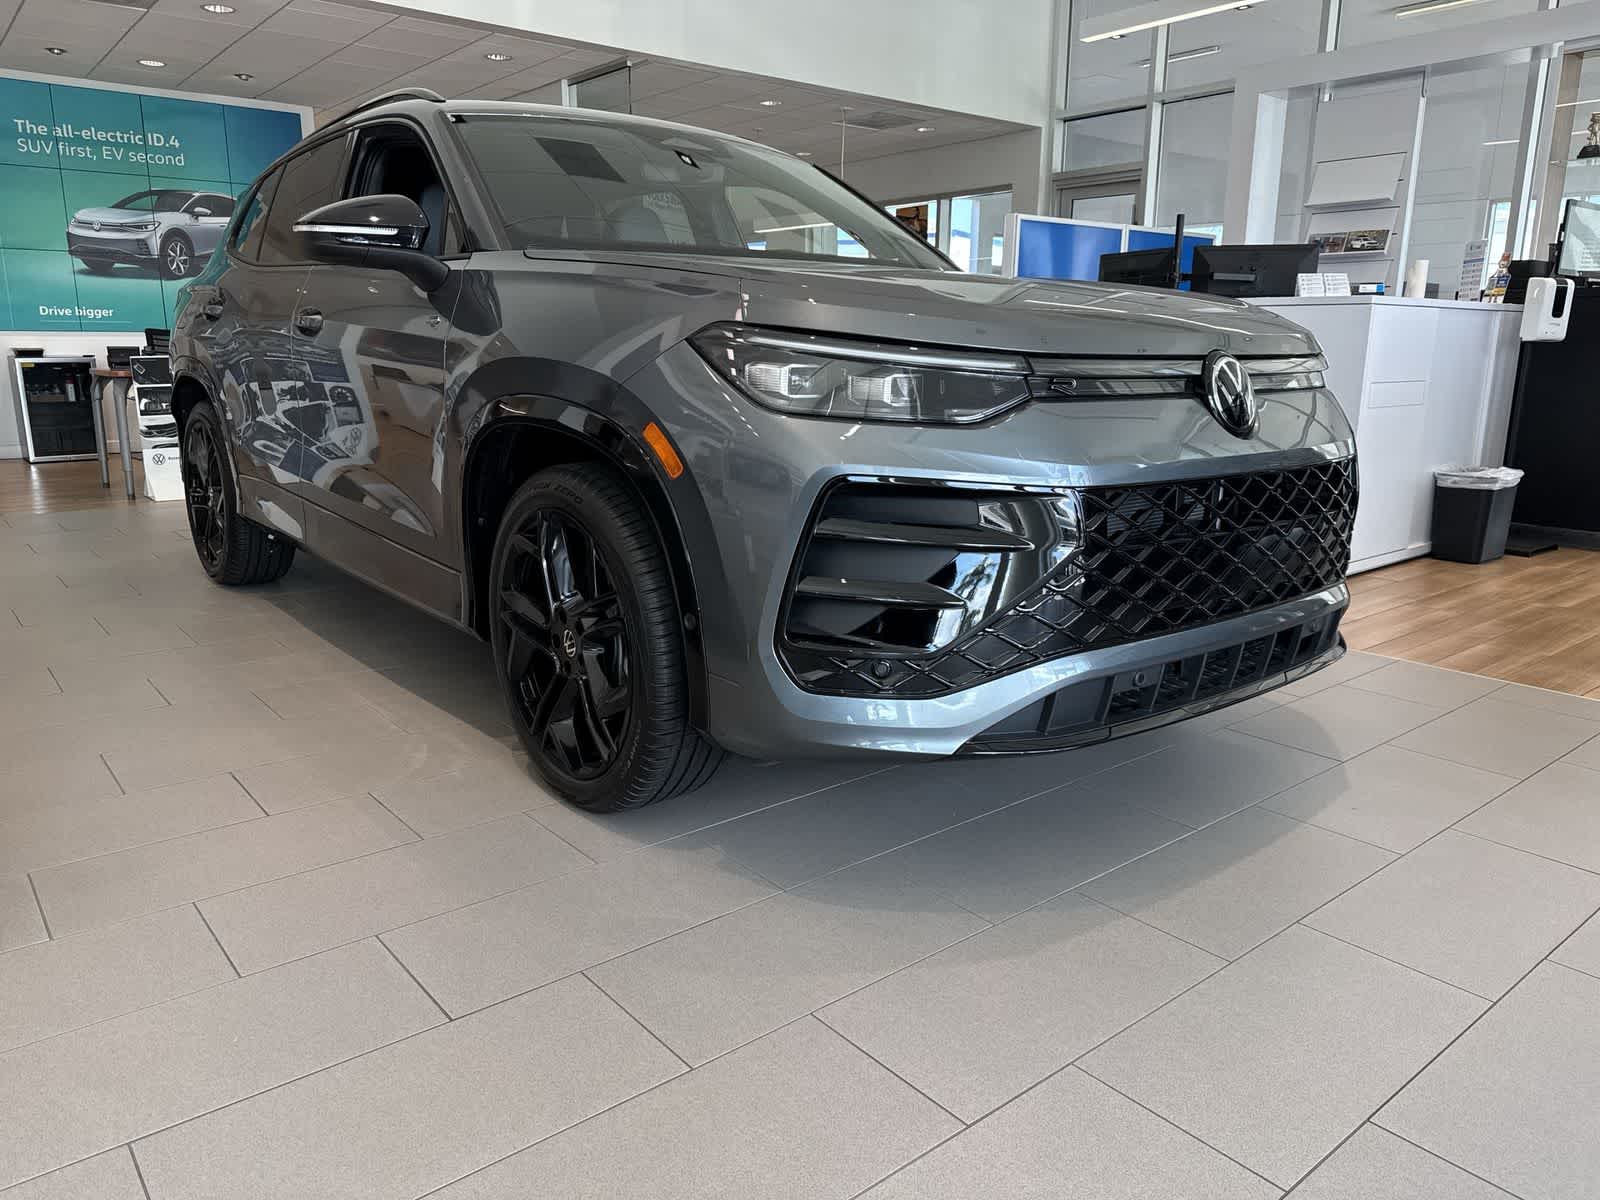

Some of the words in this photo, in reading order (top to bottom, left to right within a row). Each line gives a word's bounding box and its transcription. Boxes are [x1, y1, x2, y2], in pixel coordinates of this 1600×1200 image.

[14, 119, 48, 136] The
[53, 124, 145, 145] all-electric
[148, 133, 180, 148] ID.4
[16, 138, 53, 155] SUV
[58, 142, 97, 161] first,
[103, 146, 124, 161] EV
[128, 151, 185, 166] second
[39, 305, 72, 316] Drive
[75, 306, 114, 319] bigger
